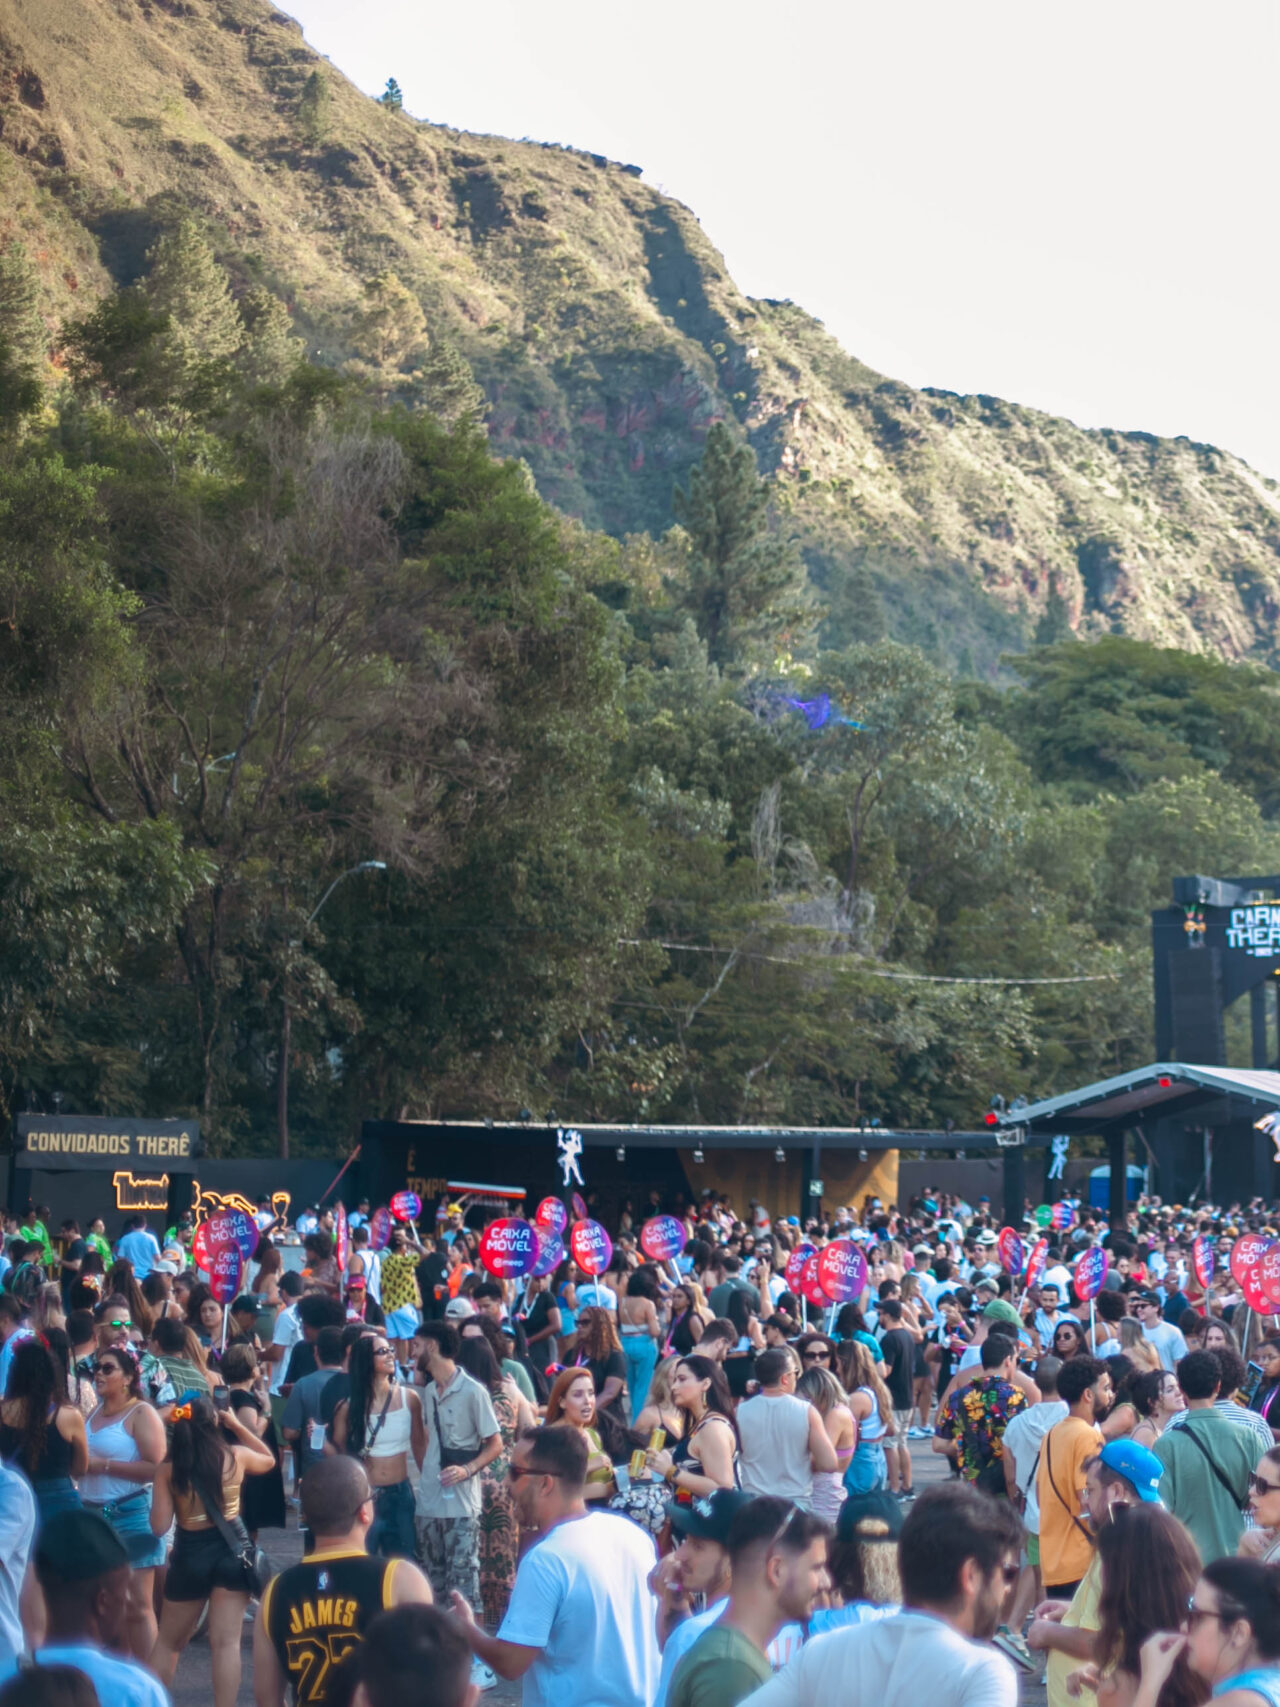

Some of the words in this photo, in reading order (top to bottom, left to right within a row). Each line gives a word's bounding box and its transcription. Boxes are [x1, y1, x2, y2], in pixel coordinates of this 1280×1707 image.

[27, 1132, 130, 1154] CONVIDADOS
[136, 1132, 190, 1156] THERÊ
[211, 1214, 247, 1231] CAIXA
[210, 1226, 252, 1244] MÓVEL
[491, 1227, 530, 1239] CAIXA
[575, 1226, 602, 1240] CAIXA
[486, 1238, 532, 1252] MÓVEL
[1241, 1241, 1269, 1253] CAIX
[828, 1248, 861, 1266] CAIXA
[290, 1599, 357, 1634] JAMES
